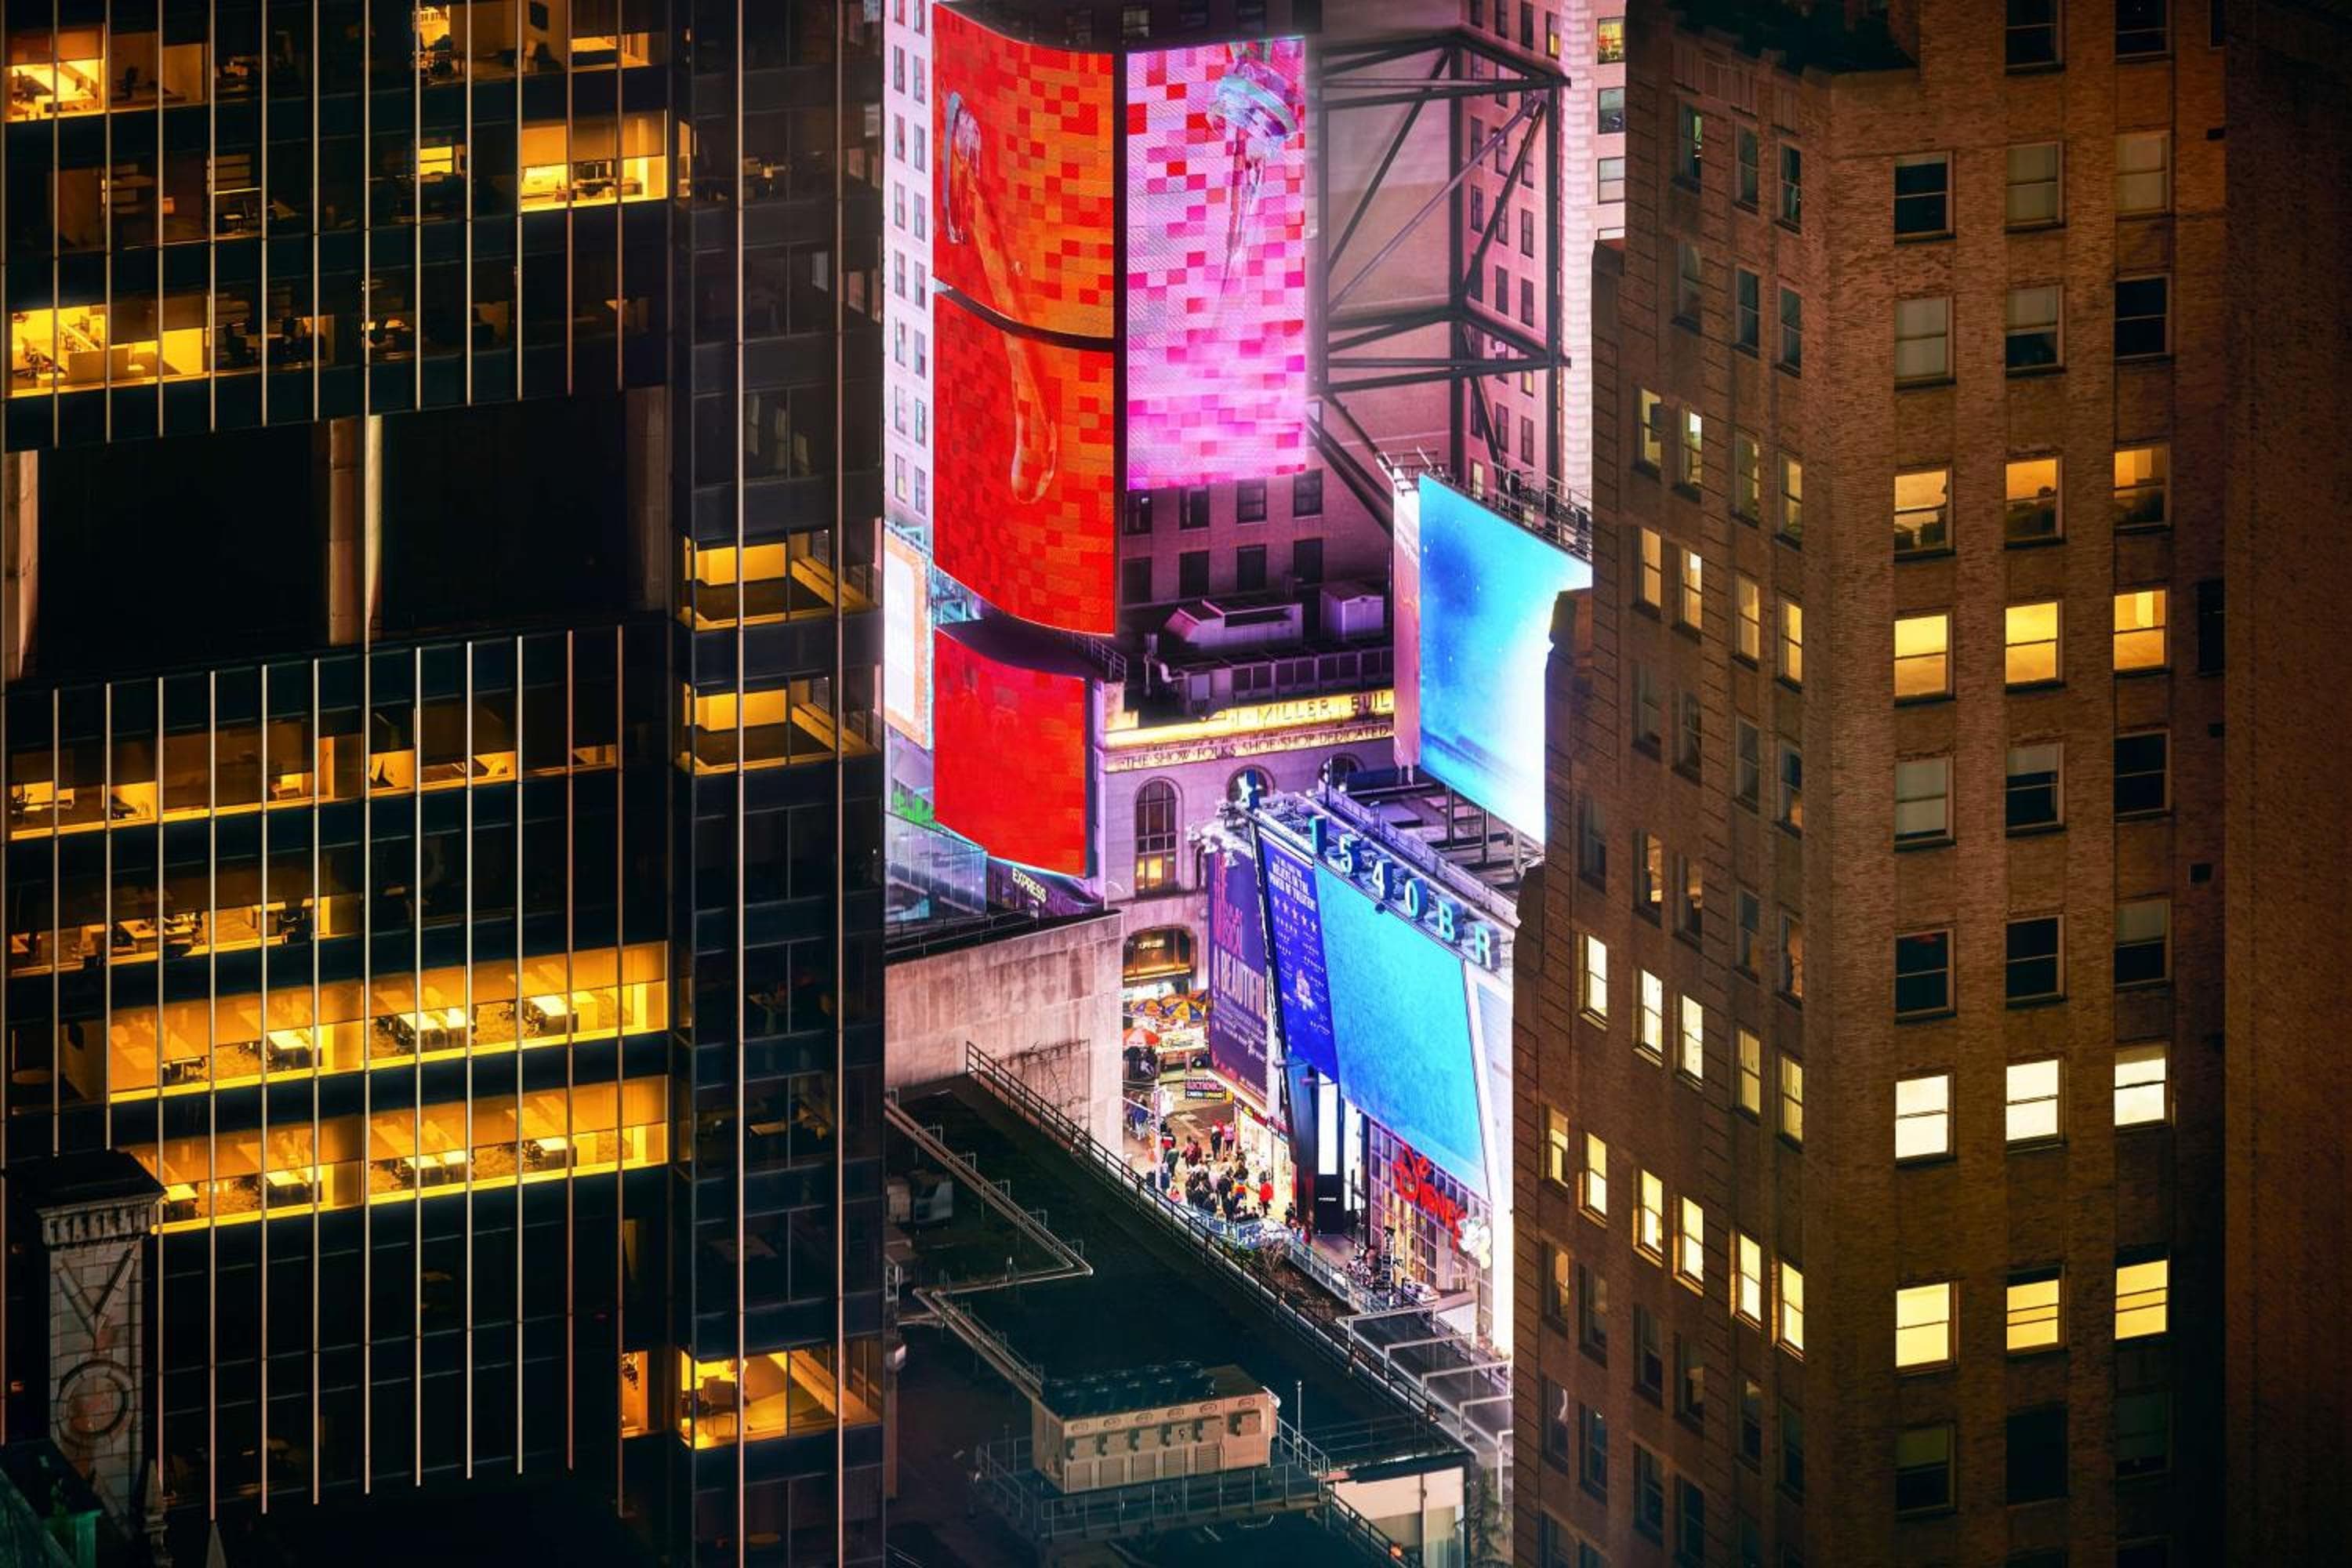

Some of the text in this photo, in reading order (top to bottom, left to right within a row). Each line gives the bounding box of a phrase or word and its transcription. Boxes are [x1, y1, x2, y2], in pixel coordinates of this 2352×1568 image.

[1257, 698, 1331, 724] MILLER
[1125, 725, 1388, 768] THE SHOW FOLKS SHOE SHOP DEDICATED
[1012, 866, 1047, 903] EXPRESS
